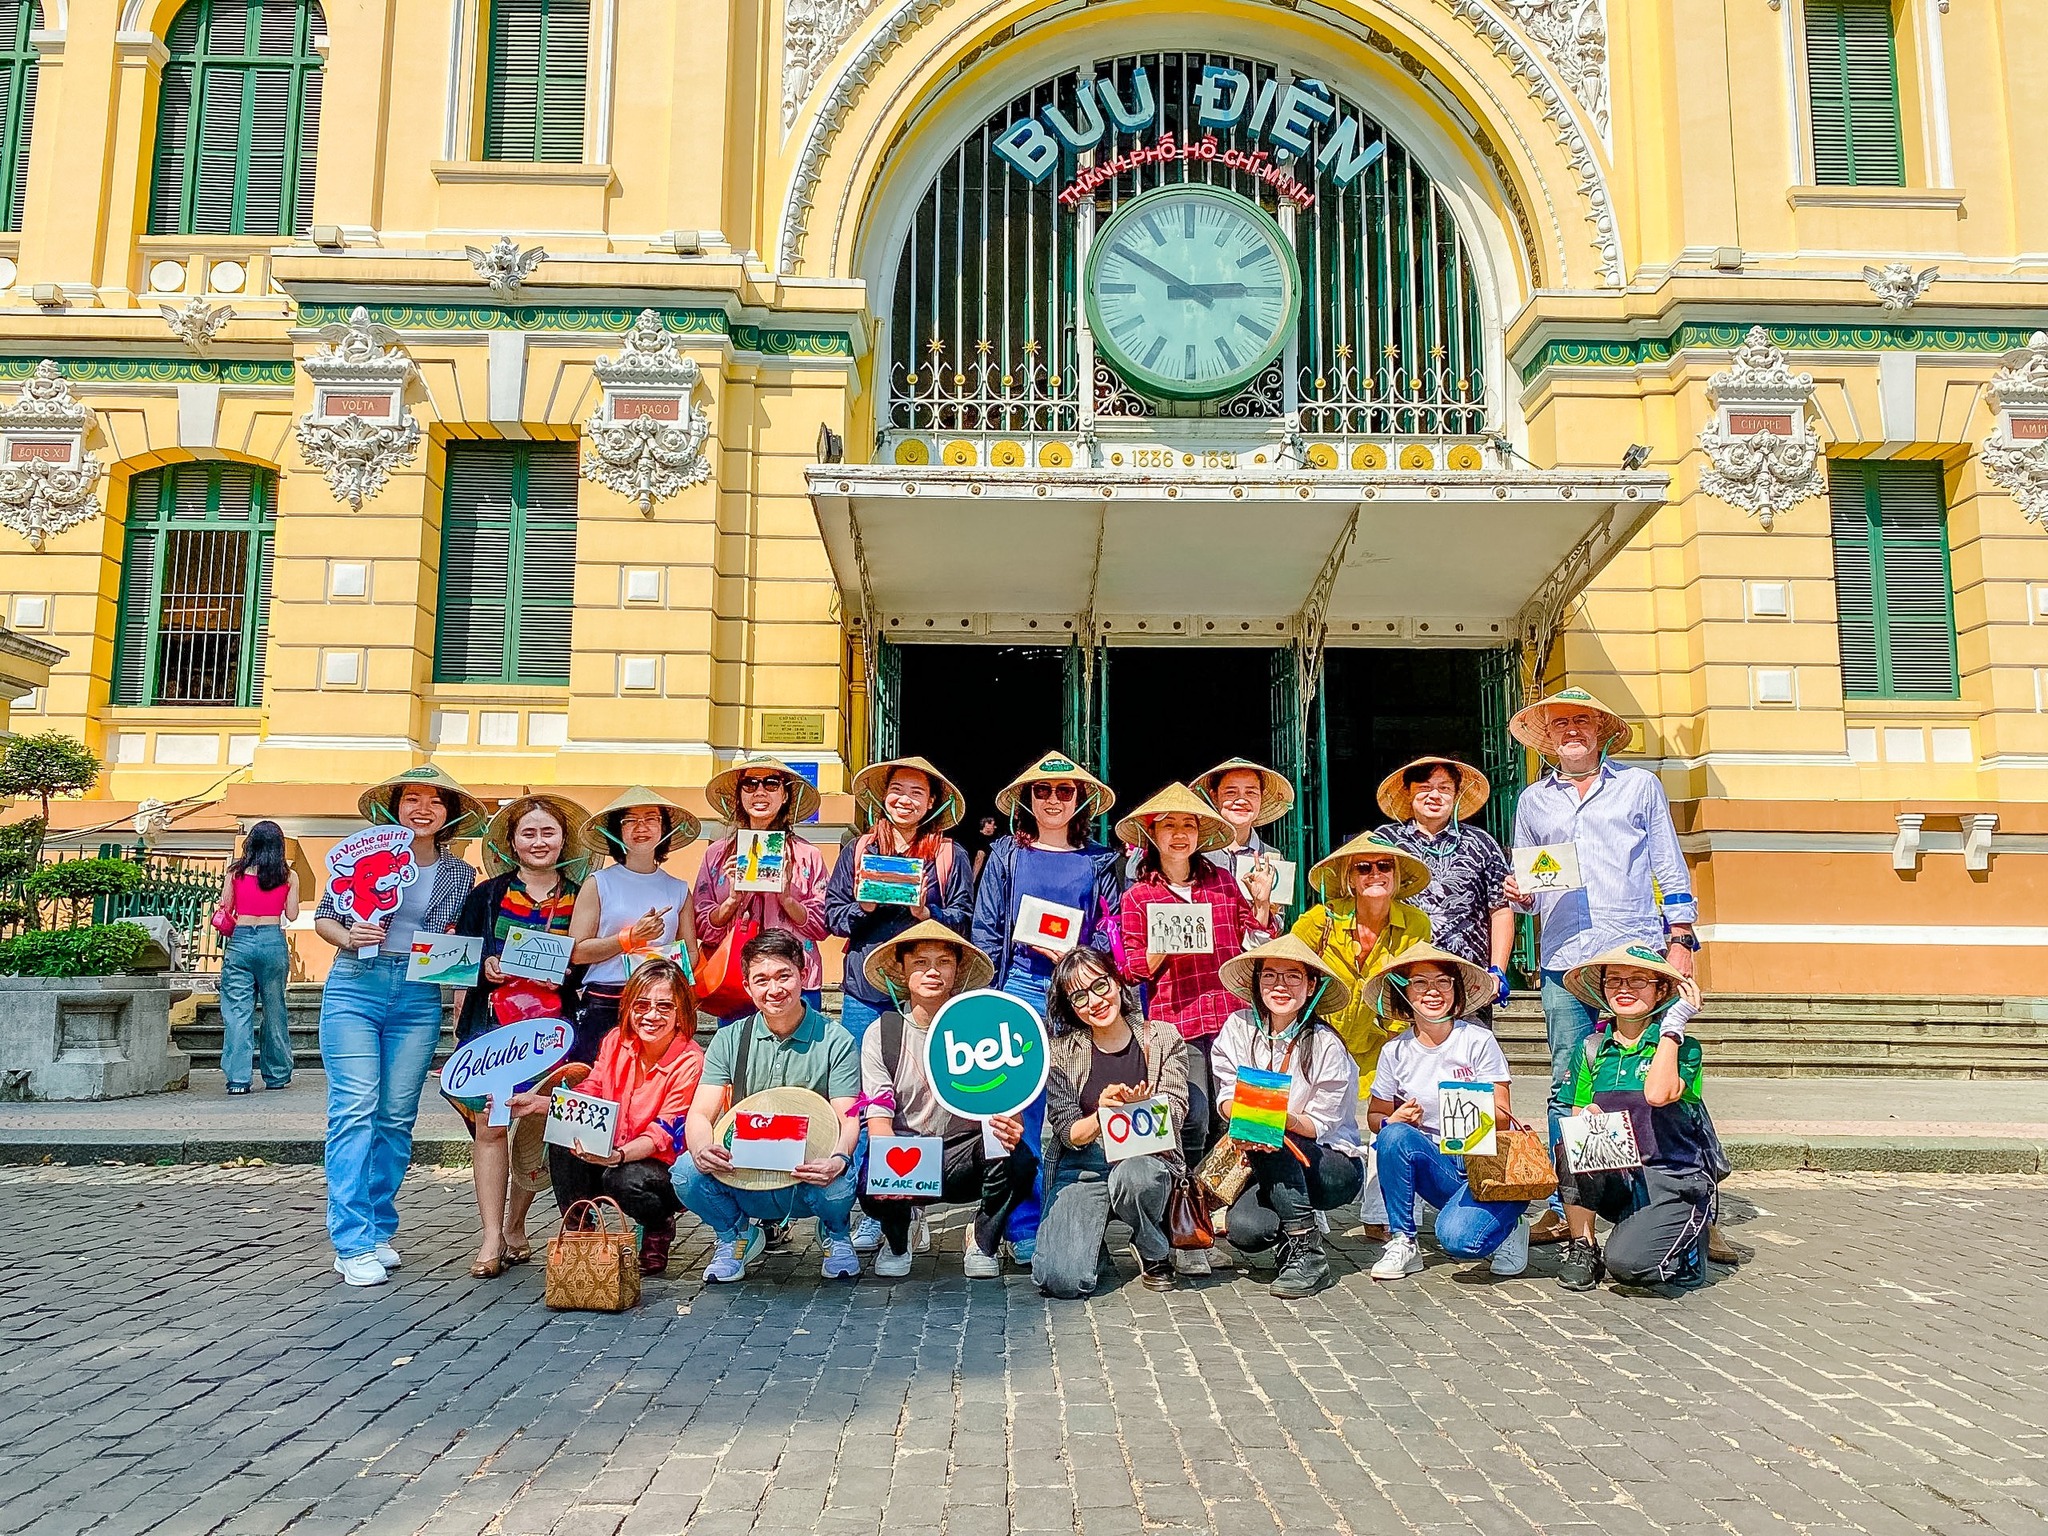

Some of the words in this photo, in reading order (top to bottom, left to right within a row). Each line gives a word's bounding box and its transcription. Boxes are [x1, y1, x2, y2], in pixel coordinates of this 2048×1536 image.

[1193, 65, 1386, 188] ĐIỆN
[342, 400, 375, 411] VOLTA
[1741, 419, 1781, 430] CHAPPE
[1132, 449, 1174, 468] 1886
[1202, 449, 1238, 469] 1891
[340, 836, 376, 854] Vache
[377, 831, 394, 843] qui
[395, 830, 409, 841] rit
[448, 1036, 529, 1090] Belcube
[870, 1178, 890, 1188] WE
[892, 1179, 913, 1189] ARE
[915, 1181, 940, 1191] ONE
